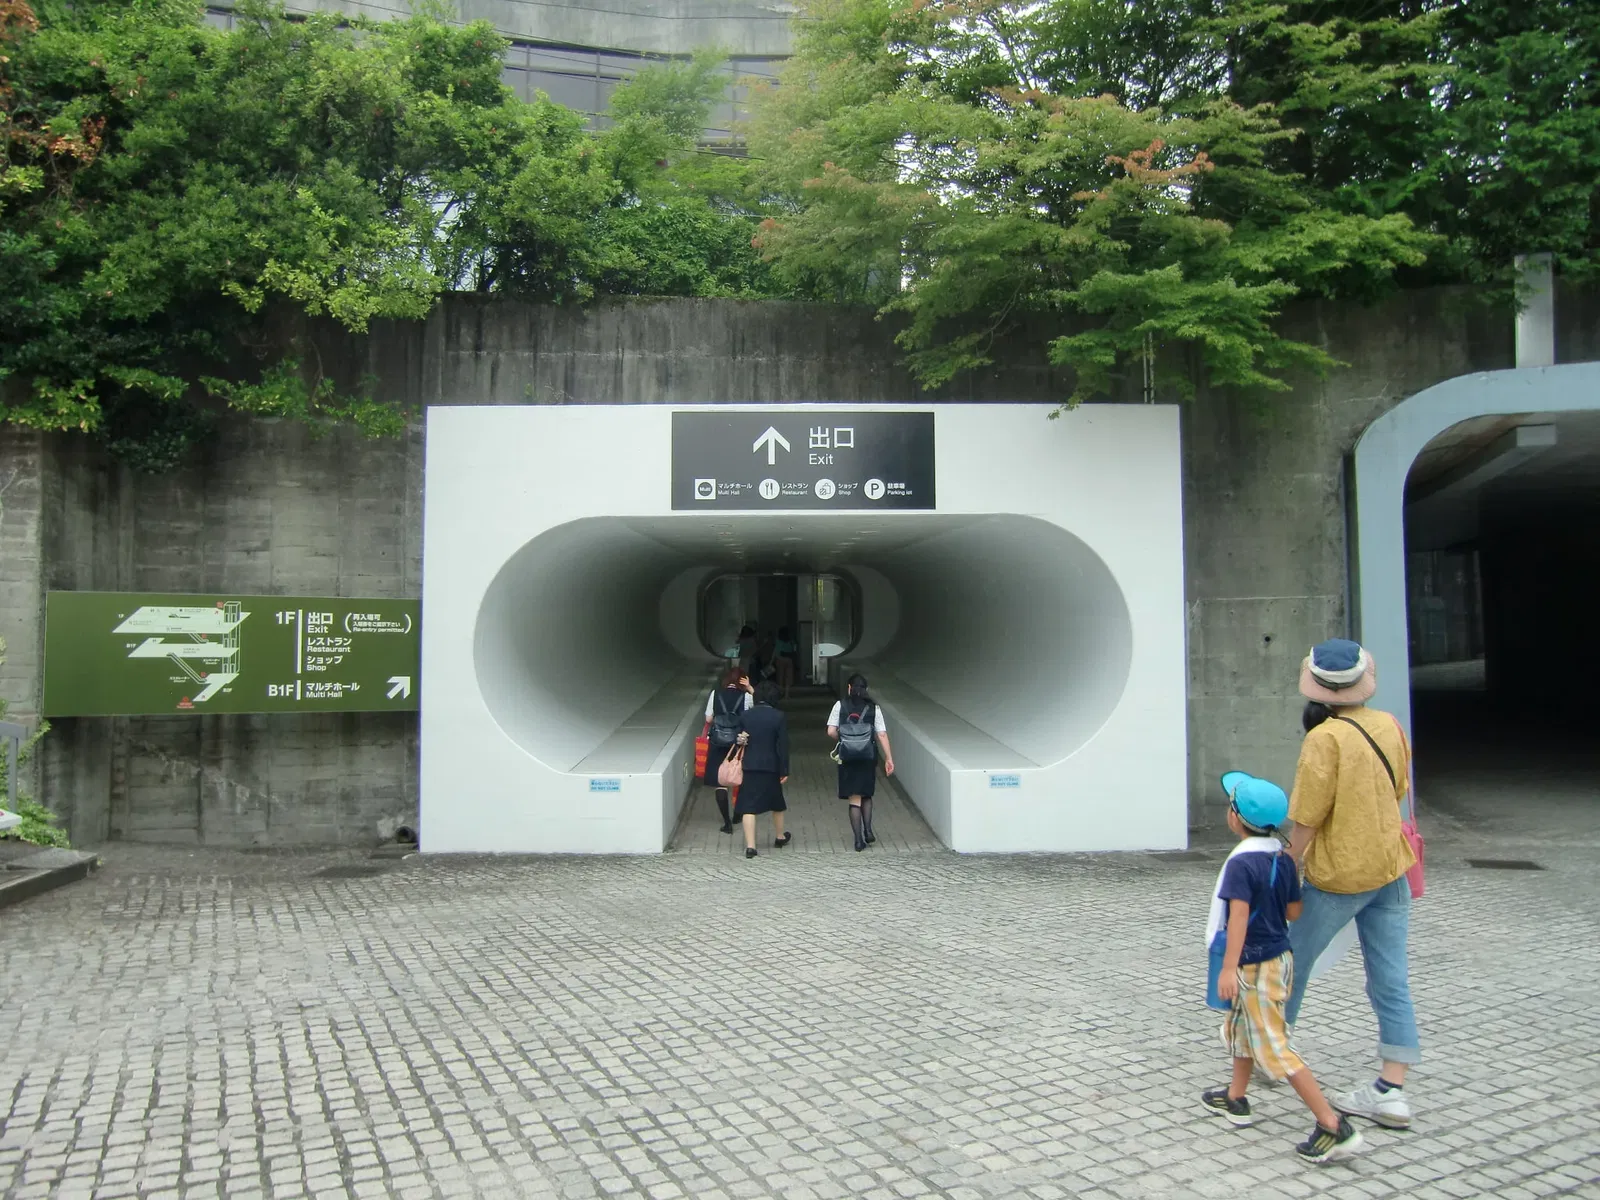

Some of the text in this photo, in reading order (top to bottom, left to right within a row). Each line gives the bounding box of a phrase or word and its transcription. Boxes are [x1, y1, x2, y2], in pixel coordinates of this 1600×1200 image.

[808, 426, 855, 449] 出口
[808, 453, 834, 466] Exit
[781, 482, 809, 490] レストラン
[838, 482, 858, 490] ショップ
[275, 611, 296, 625] 1F
[307, 611, 333, 625] 出口
[307, 625, 329, 634] Exit
[307, 637, 352, 646] レストラン
[306, 645, 351, 653] Restaurant
[306, 655, 343, 665] ショップ
[306, 664, 327, 672] Shop
[268, 684, 295, 697] B1F
[305, 682, 361, 692] マルチホール
[305, 690, 326, 698] Multi
